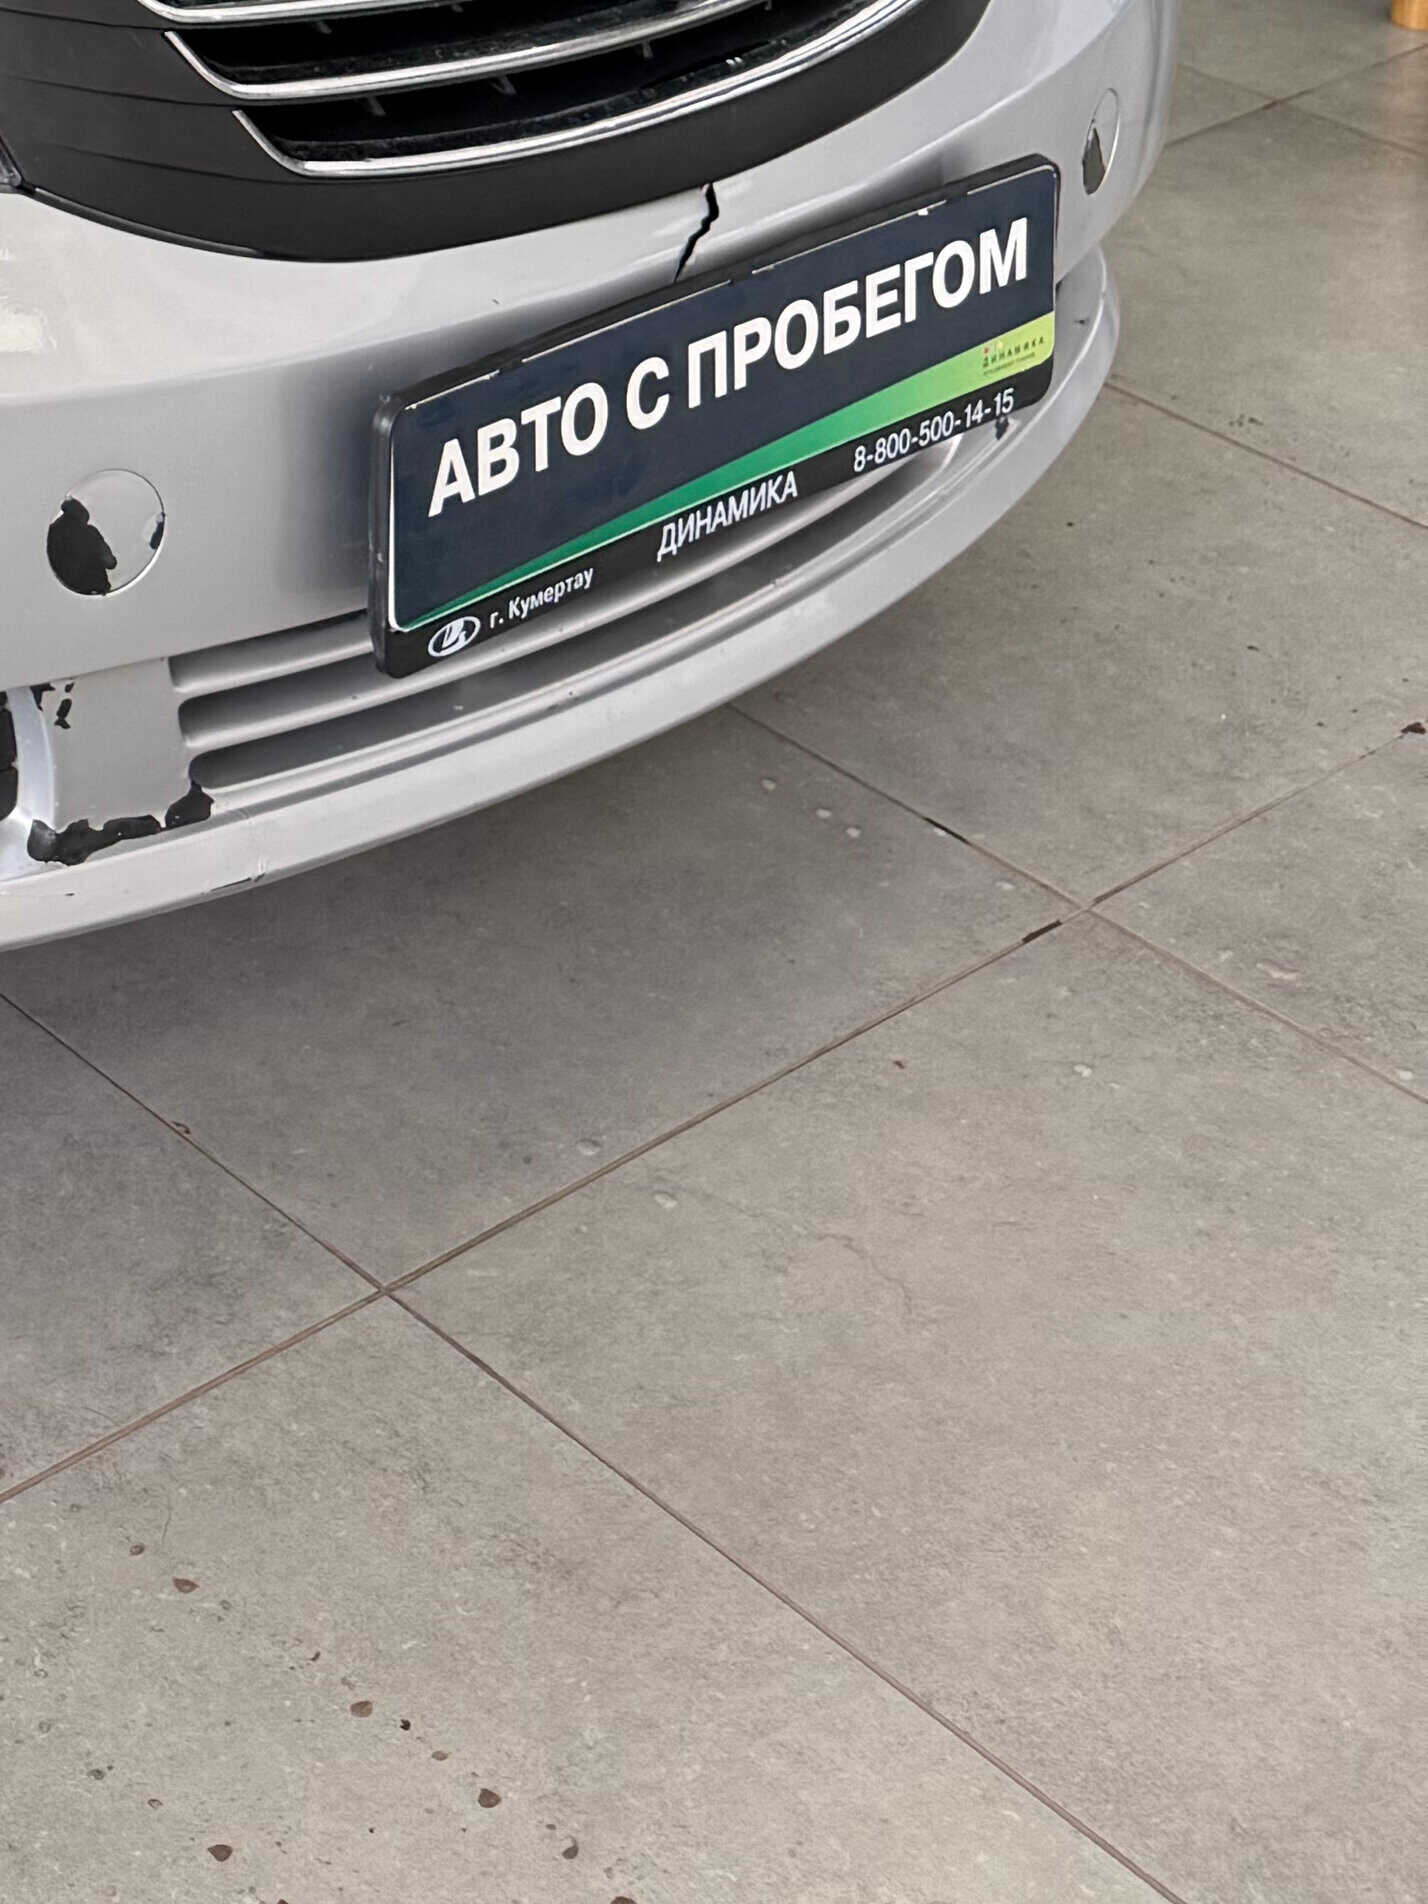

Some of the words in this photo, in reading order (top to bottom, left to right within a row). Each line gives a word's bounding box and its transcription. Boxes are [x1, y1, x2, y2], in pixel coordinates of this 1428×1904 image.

[427, 381, 609, 518] АВТО
[625, 356, 671, 431] С
[687, 217, 1029, 409] ПРОБЕГОМ
[853, 387, 1015, 473] 8-800-500-14-15
[656, 471, 799, 563] ДИНАМИКА
[489, 611, 504, 629] г.
[508, 567, 594, 619] Кумертау
